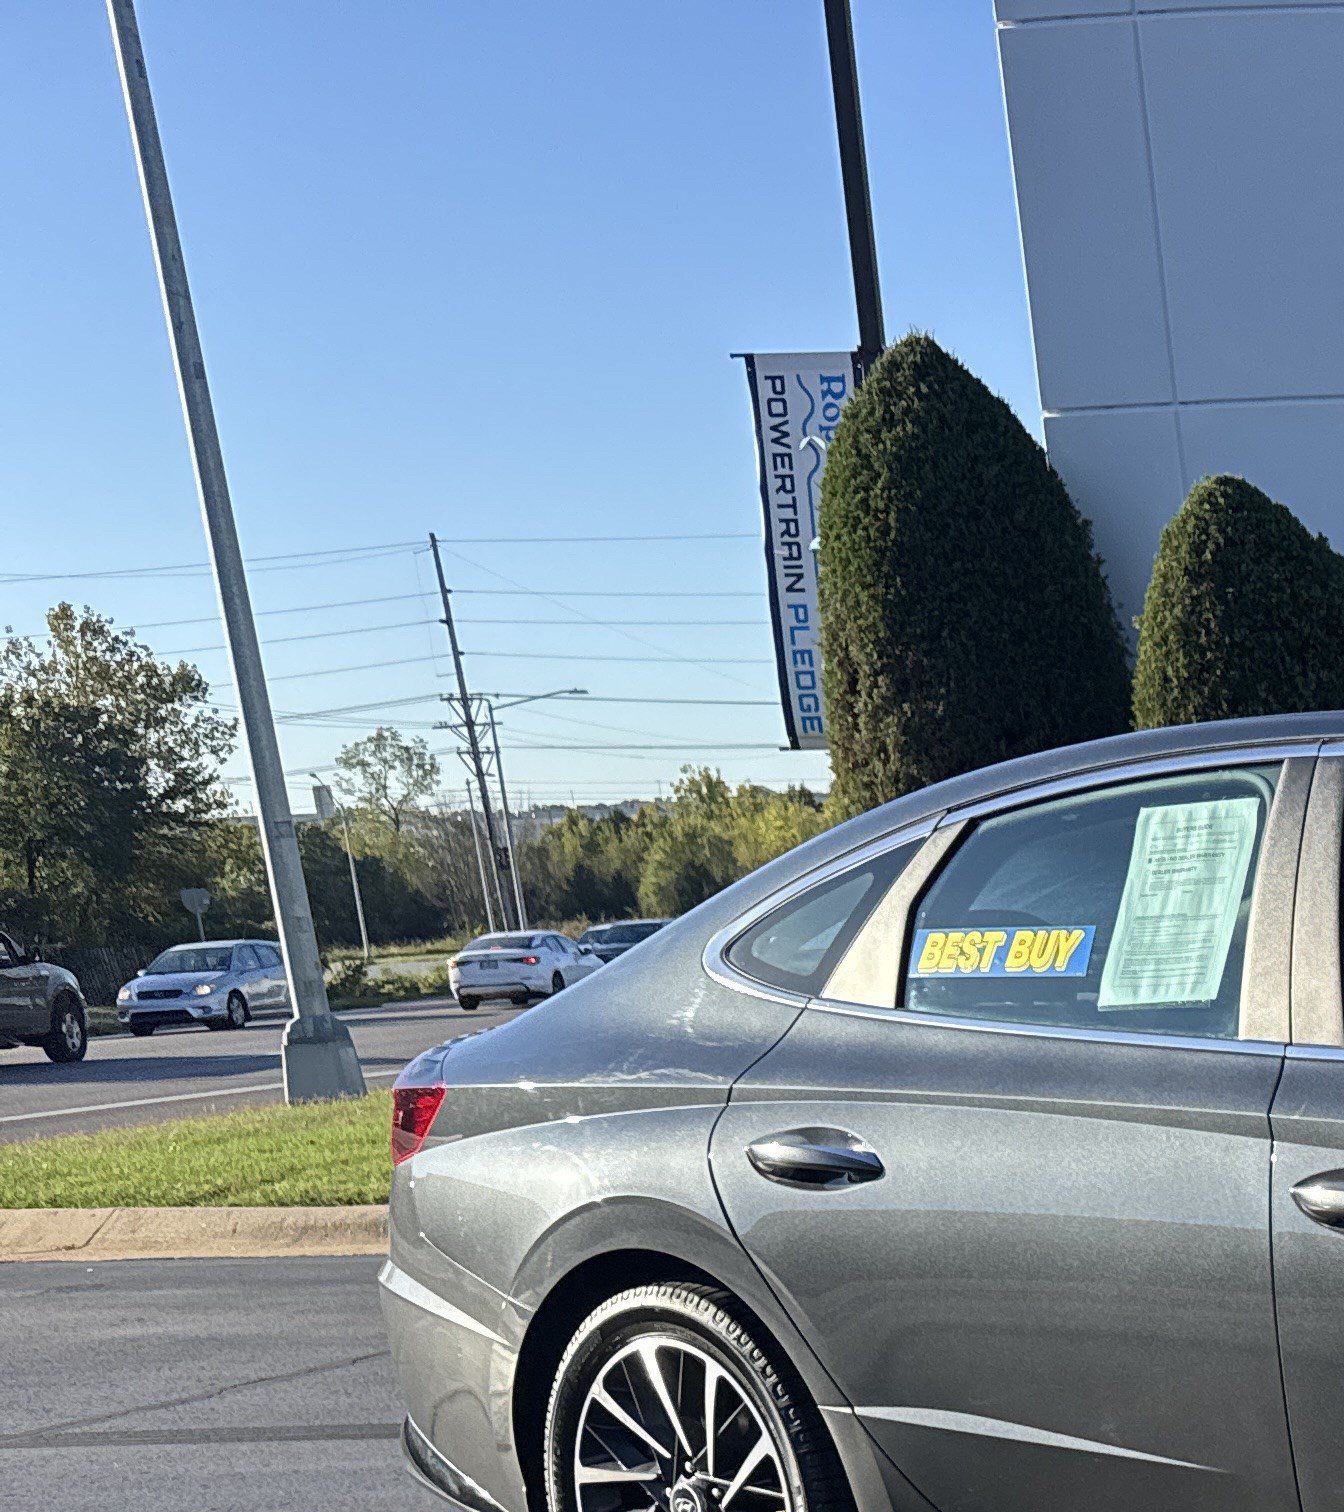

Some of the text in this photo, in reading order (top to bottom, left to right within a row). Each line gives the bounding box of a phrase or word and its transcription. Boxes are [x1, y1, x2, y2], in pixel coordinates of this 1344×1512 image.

[819, 374, 846, 442] Rop
[764, 375, 824, 734] POWERTRAIN PLEDGE
[917, 931, 1007, 973] BEST
[1004, 929, 1086, 973] BUY
